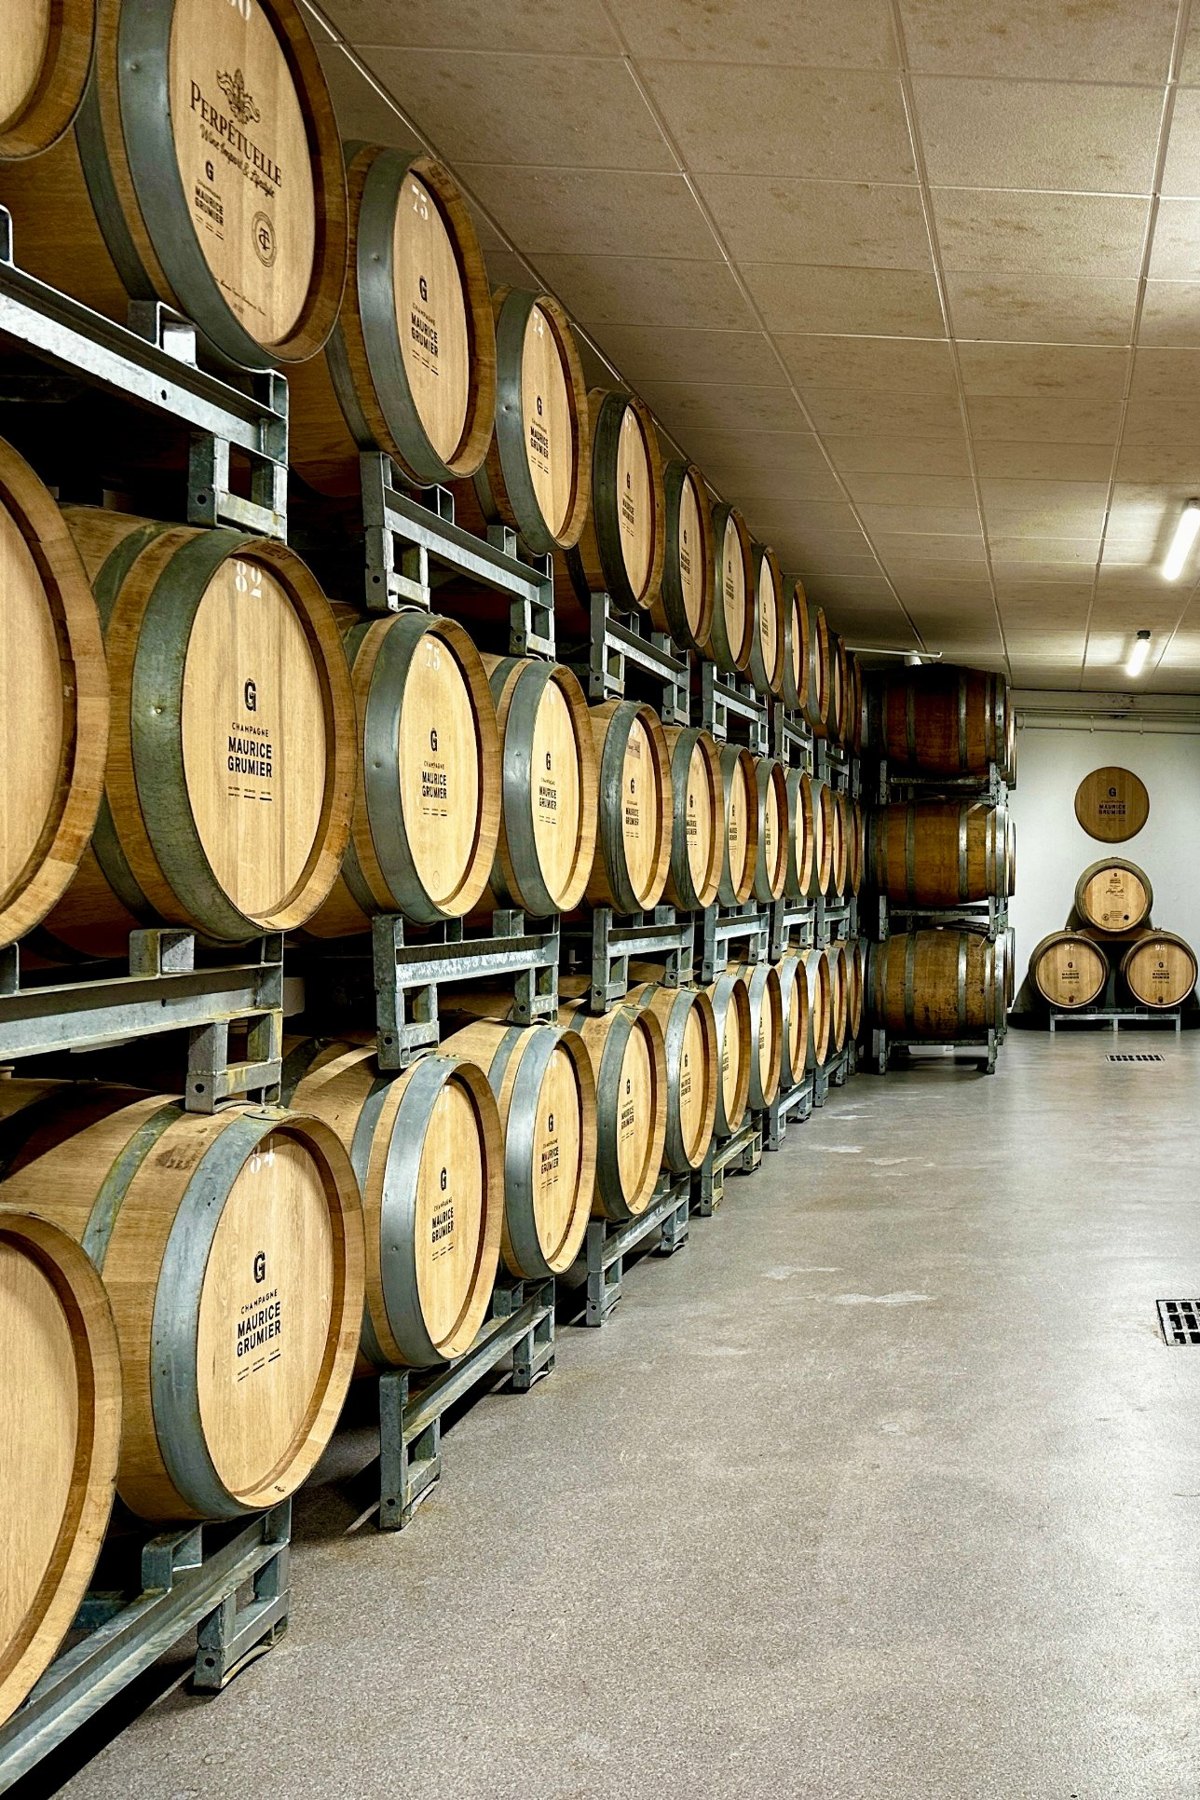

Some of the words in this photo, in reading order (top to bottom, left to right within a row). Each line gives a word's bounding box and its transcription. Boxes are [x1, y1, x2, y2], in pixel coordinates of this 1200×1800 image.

[190, 79, 282, 188] PERPÉTUELLE
[205, 160, 214, 182] G
[419, 274, 428, 303] G
[411, 311, 438, 344] MAURICE
[411, 326, 439, 358] GRUMIER
[537, 395, 543, 416] G
[235, 561, 262, 599] 82
[244, 678, 257, 712] G
[231, 721, 269, 738] CHAMPAGNE
[430, 727, 438, 752] G
[228, 736, 272, 760] MAURICE
[228, 755, 272, 778] GRUMIER
[546, 752, 551, 771] G
[422, 771, 447, 786] MAURICE
[422, 785, 447, 799] GRUMIER
[1108, 787, 1117, 797] G
[549, 1112, 554, 1133] G
[440, 1166, 447, 1191] G
[432, 1207, 454, 1229] MAURICE
[253, 1251, 265, 1283] G
[241, 1288, 278, 1315] CHAMPAGNE
[237, 1301, 281, 1338] MAURICE
[237, 1319, 281, 1358] GRUMIER
